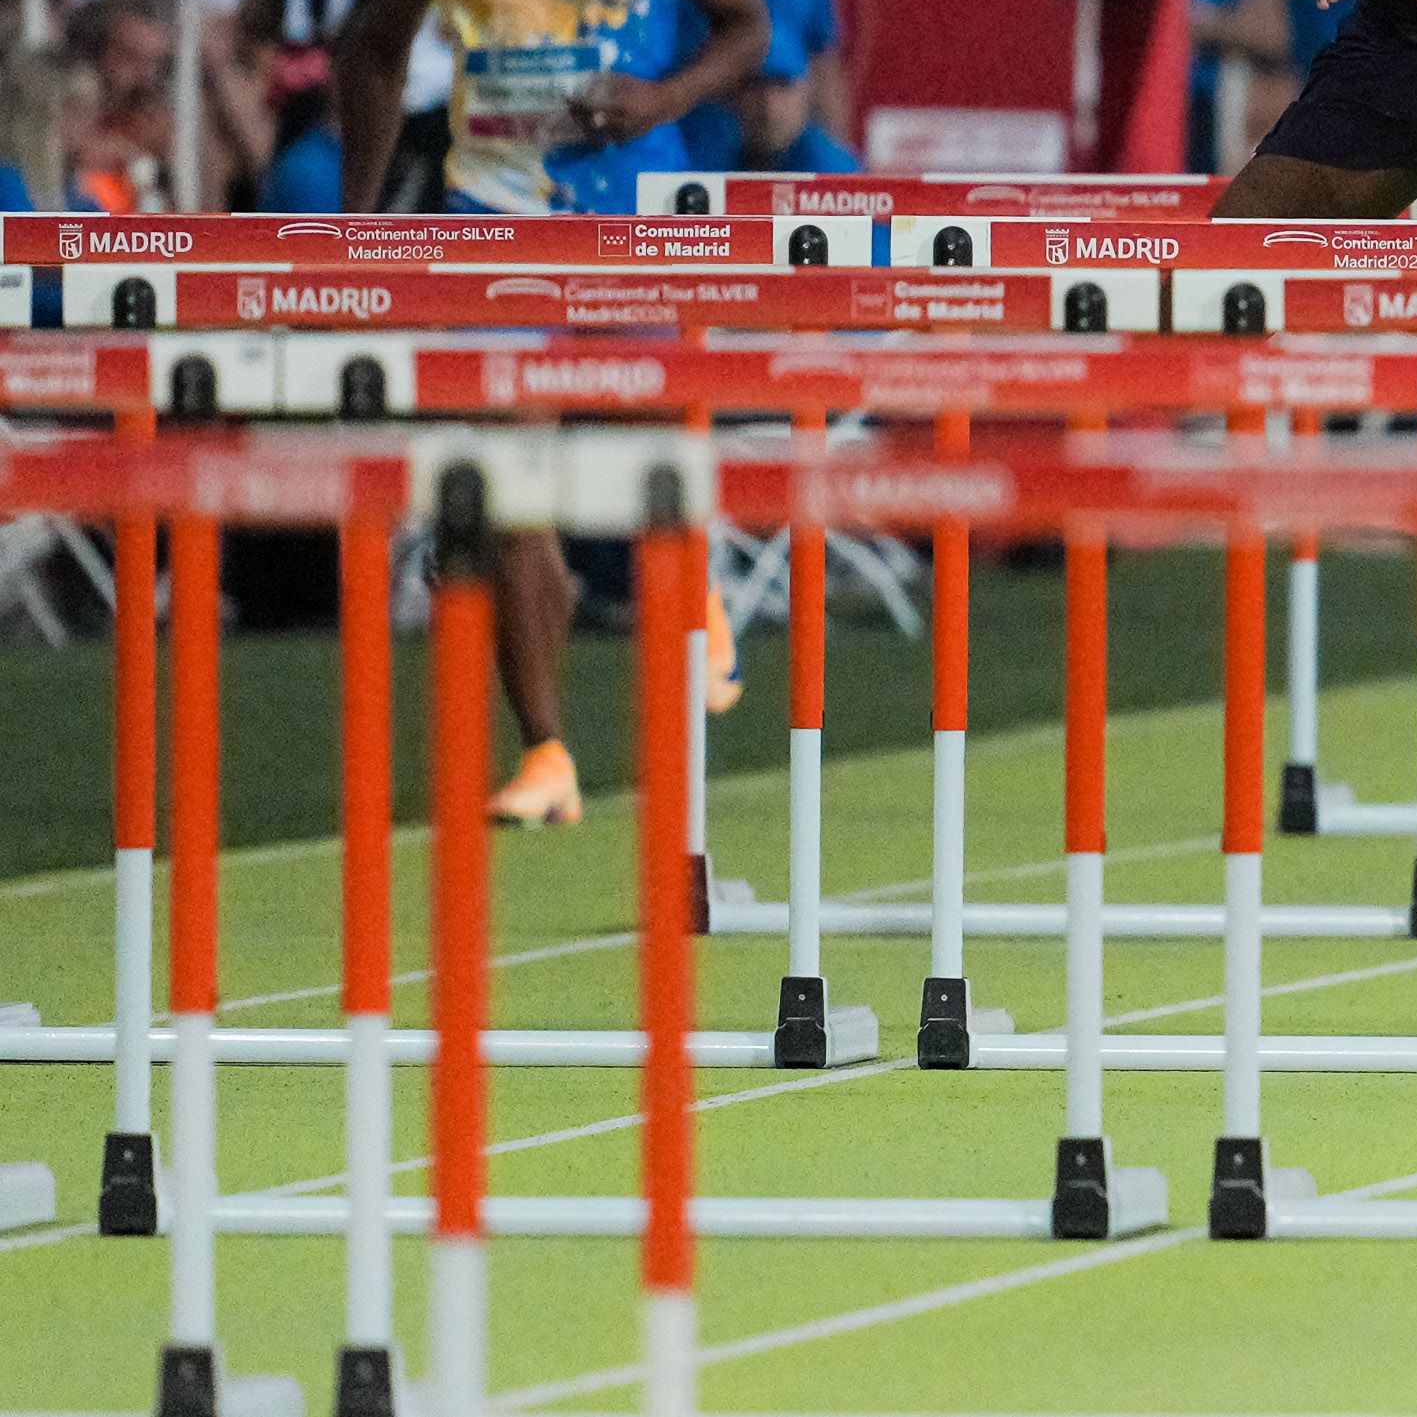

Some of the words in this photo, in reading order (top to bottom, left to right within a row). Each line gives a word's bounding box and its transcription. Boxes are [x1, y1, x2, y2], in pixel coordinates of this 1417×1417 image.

[799, 192, 894, 215] MADRID
[345, 227, 427, 241] Continental
[429, 227, 461, 241] Tour
[462, 227, 515, 241] SILVER
[635, 224, 731, 239] Comunidad
[90, 232, 192, 257] MADRID
[635, 242, 661, 257] de
[665, 242, 729, 256] Madrid
[1331, 235, 1413, 250] Continental
[348, 245, 444, 260] Madrid2026
[1077, 238, 1179, 263] MADRID
[273, 288, 391, 318] MADRID
